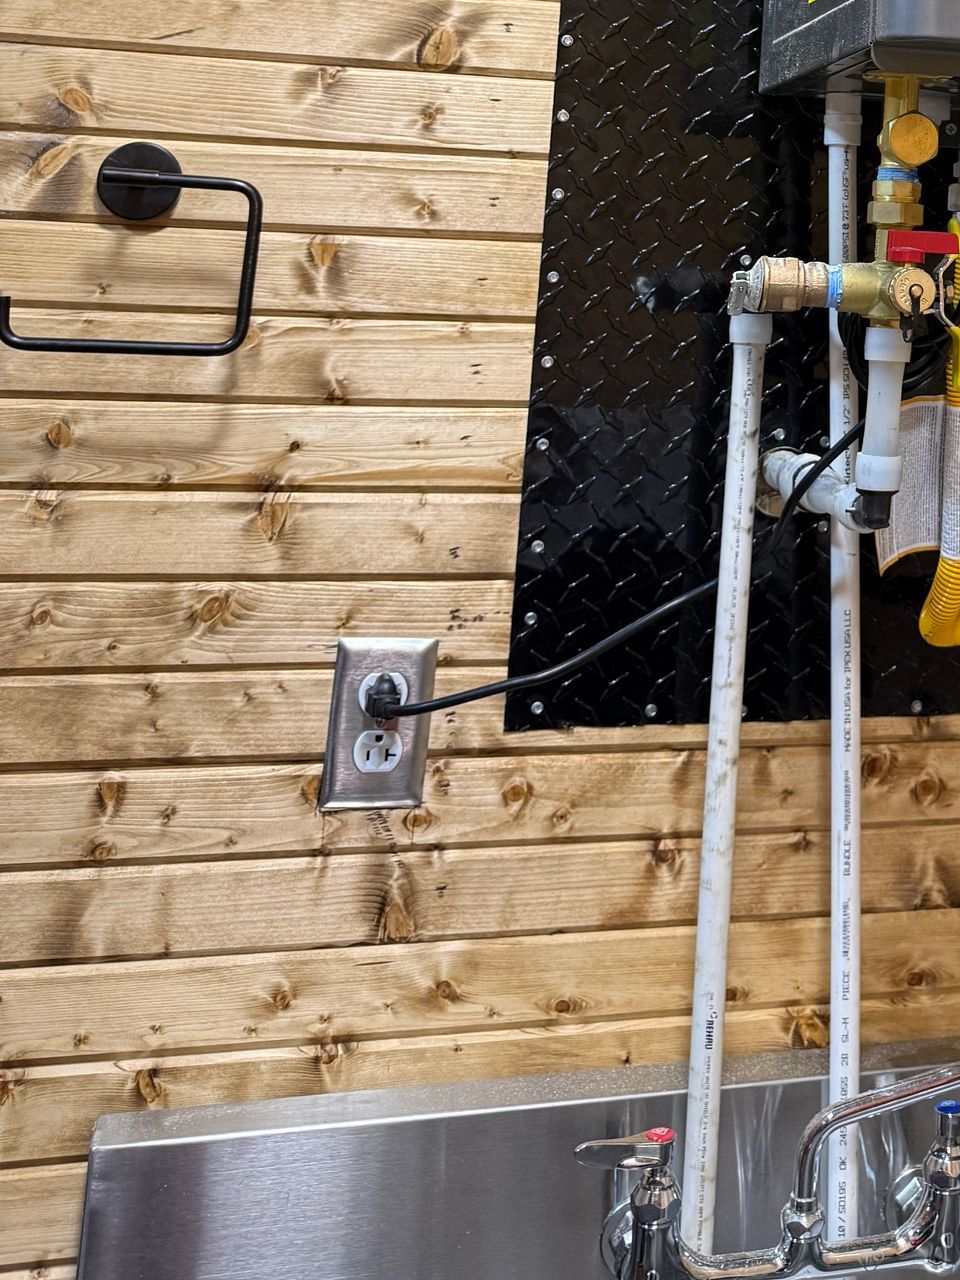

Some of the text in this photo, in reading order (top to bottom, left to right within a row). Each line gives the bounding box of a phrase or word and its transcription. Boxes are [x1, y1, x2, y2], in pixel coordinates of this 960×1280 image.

[842, 364, 850, 382] SCH
[843, 404, 851, 425] 1/2"
[843, 609, 851, 627] LLC
[844, 692, 852, 713] USA
[844, 713, 852, 724] IN
[844, 727, 852, 752] MADE
[843, 839, 851, 877] BUNDLE
[842, 970, 850, 1001] PIECE
[704, 1020, 715, 1050] REHAU
